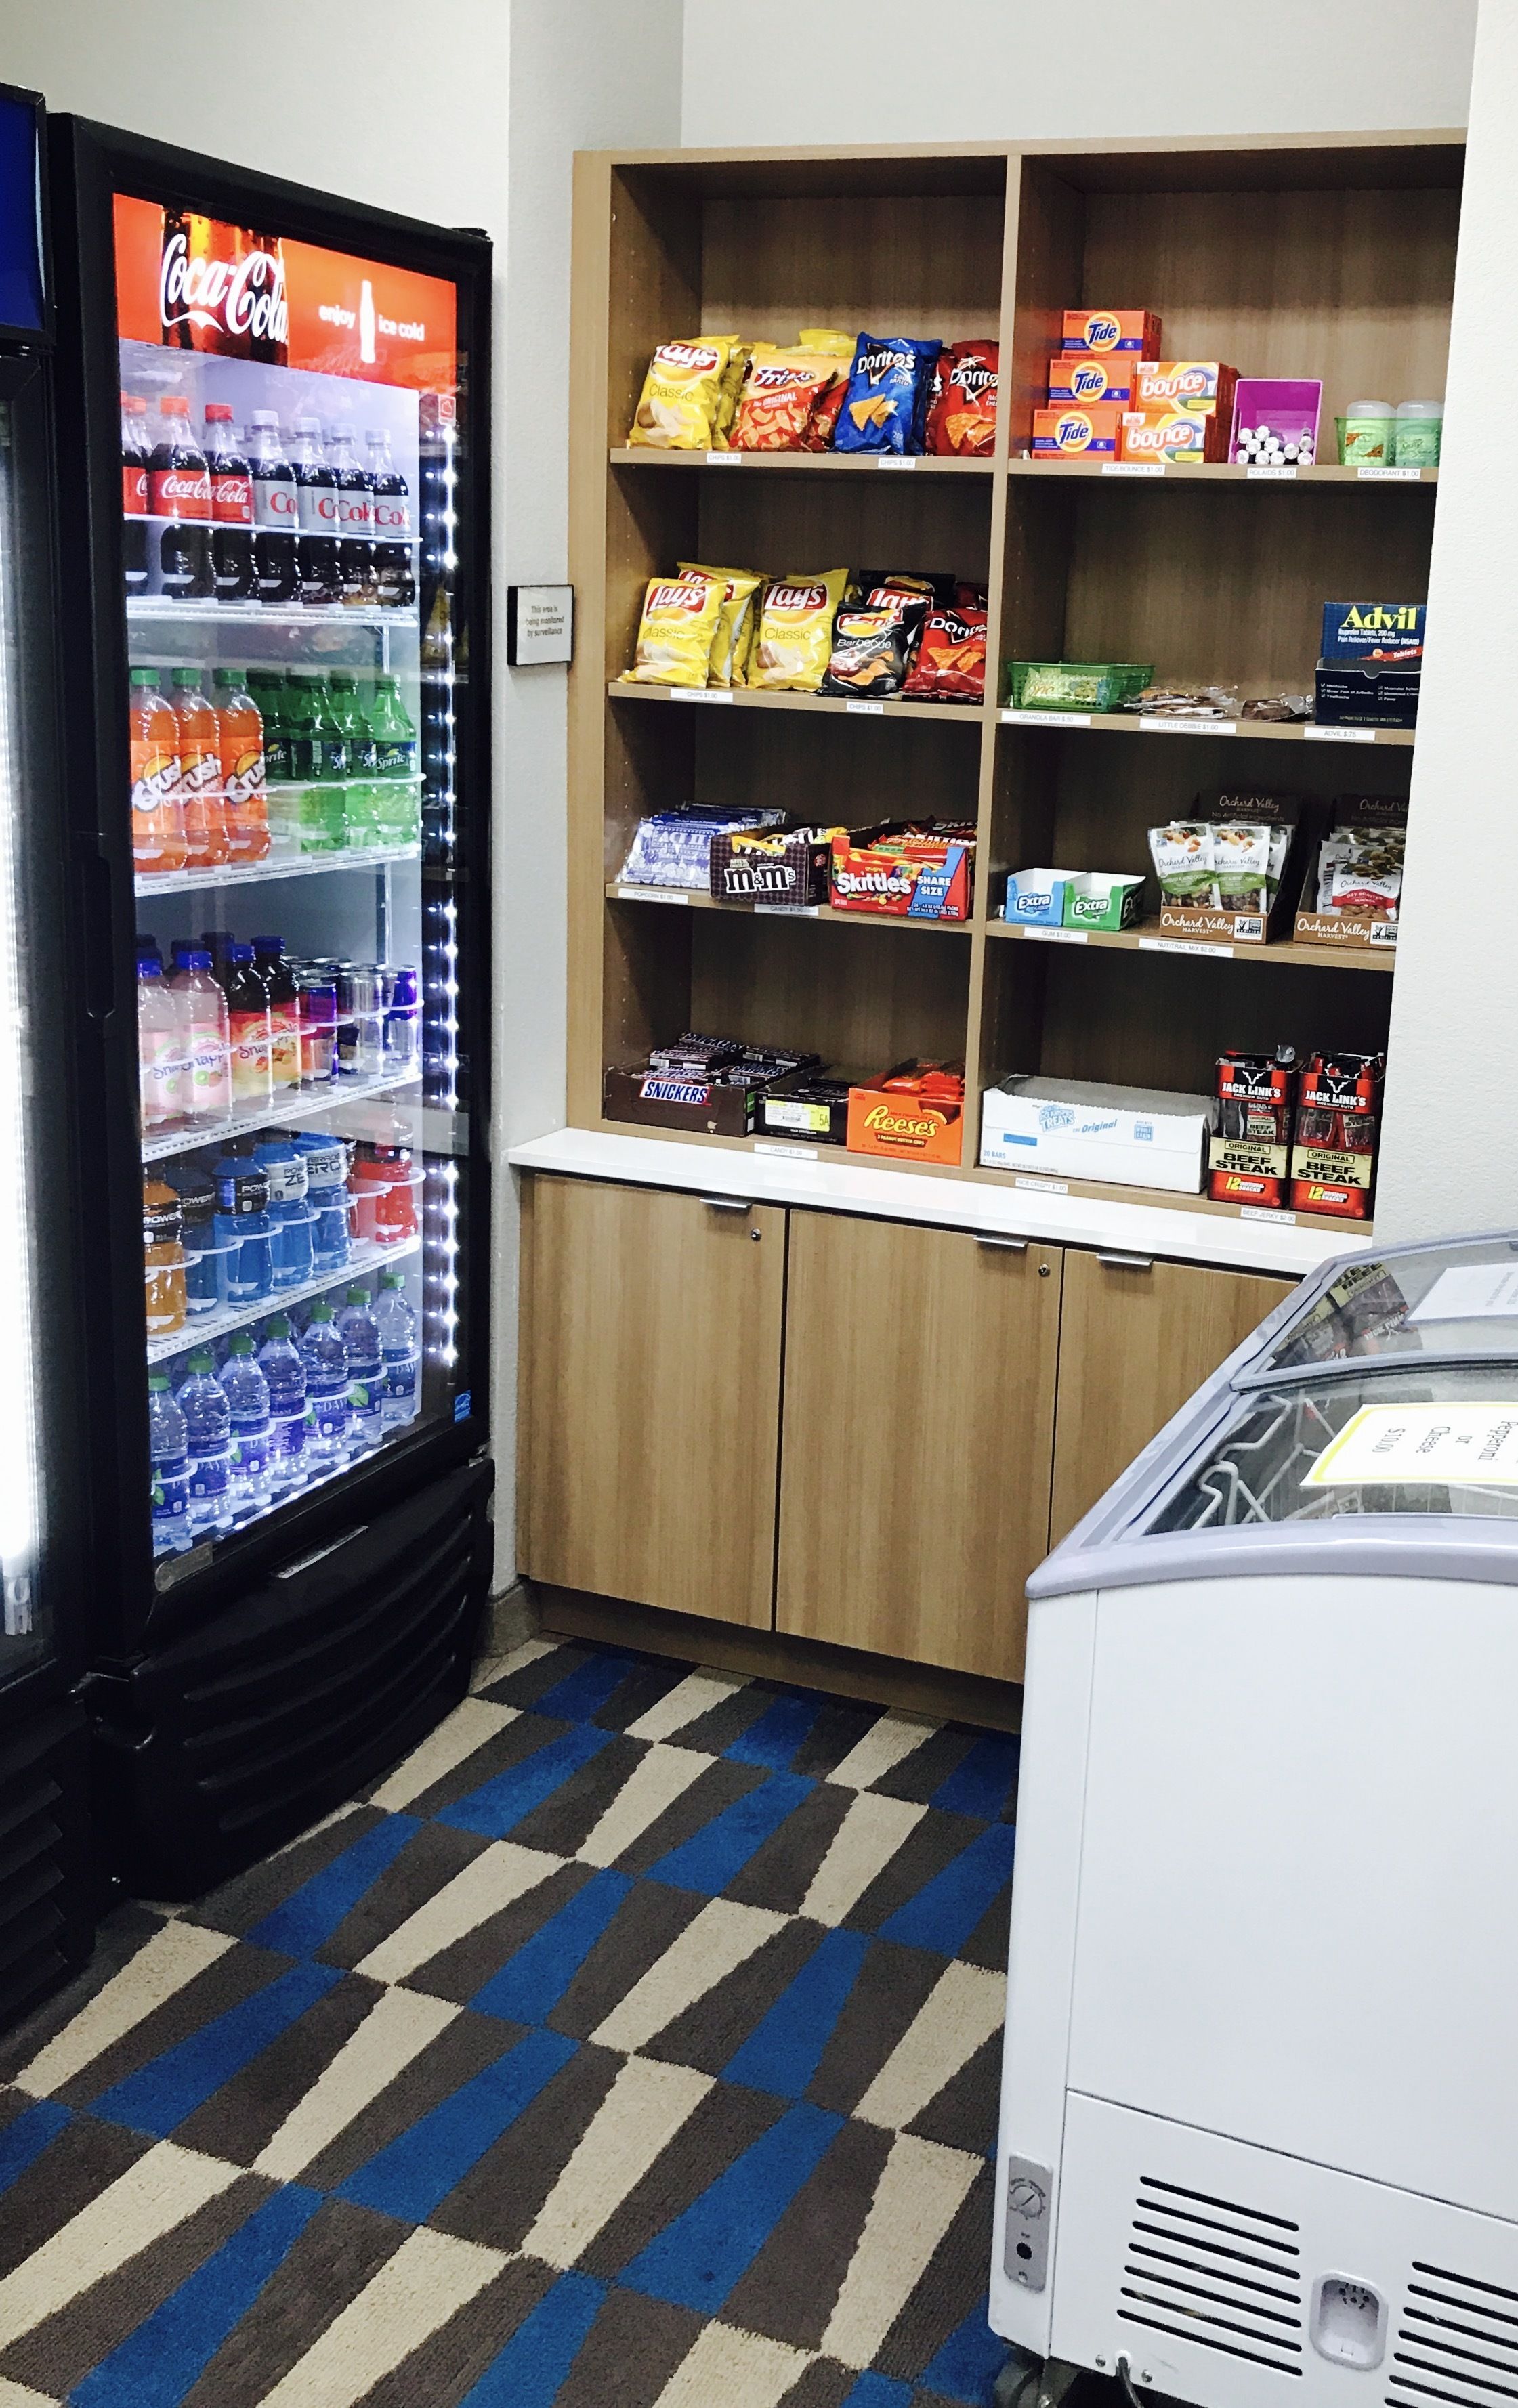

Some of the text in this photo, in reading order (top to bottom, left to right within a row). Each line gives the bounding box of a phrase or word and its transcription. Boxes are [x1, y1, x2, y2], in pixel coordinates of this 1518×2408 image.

[161, 234, 288, 343] Coca-Cola
[318, 305, 425, 341] enjoy ice cold
[1089, 322, 1117, 344] Tide
[856, 349, 916, 374] Doritos
[949, 368, 998, 387] Dorito
[1075, 372, 1103, 394] Tide
[648, 383, 694, 402] Classic
[1141, 374, 1205, 398] bounce
[1059, 423, 1089, 444] Tide
[1128, 425, 1193, 450] bounce
[1359, 469, 1401, 477] DEODORANT
[1340, 605, 1418, 630] Advil
[534, 628, 562, 636] surveillance
[765, 627, 811, 641] Classic
[837, 639, 892, 649] Barbecue
[1393, 649, 1417, 658] Tablets
[1019, 714, 1047, 722] GRANOLA
[1203, 723, 1219, 731] $1.00
[377, 753, 406, 770] Sprite
[1219, 795, 1280, 813] Orchard Valley
[1159, 855, 1207, 868] Orchard Valley
[1240, 855, 1260, 867] Valley
[837, 871, 912, 894] Skittles
[917, 876, 952, 886] SHARE
[1372, 880, 1392, 892] Valley
[921, 886, 944, 896] SIZE
[1018, 895, 1051, 909] Extra
[1075, 899, 1108, 914] Extra
[1162, 913, 1203, 928] Orchard
[1204, 917, 1234, 934] Valley
[1296, 918, 1371, 940] Orchard Valley
[1157, 942, 1187, 951] NUT/TRAIL
[644, 1081, 707, 1104] SNICKERS
[1221, 1082, 1281, 1098] JACK LINK'S
[1305, 1090, 1366, 1106] JACK LINK'S
[864, 1104, 940, 1138] Reese's
[1040, 1115, 1075, 1131] TREATS
[1082, 1119, 1118, 1134] Original
[991, 1151, 1006, 1159] BARS
[1228, 1142, 1267, 1153] ORIGINAL
[1223, 1152, 1271, 1165] BEEF
[1311, 1151, 1351, 1162] ORIGINAL
[305, 1162, 342, 1175] ERO
[1215, 1159, 1278, 1176] STEAK
[1306, 1161, 1355, 1175] BEEF
[1030, 1180, 1051, 1188] CRISPY
[1225, 1176, 1242, 1190] 12
[1297, 1169, 1362, 1185] STEAK
[1307, 1186, 1324, 1201] 12
[1416, 1426, 1451, 1453] Cheese
[1456, 1435, 1473, 1444] or
[1477, 1421, 1518, 1461] Pepperoni
